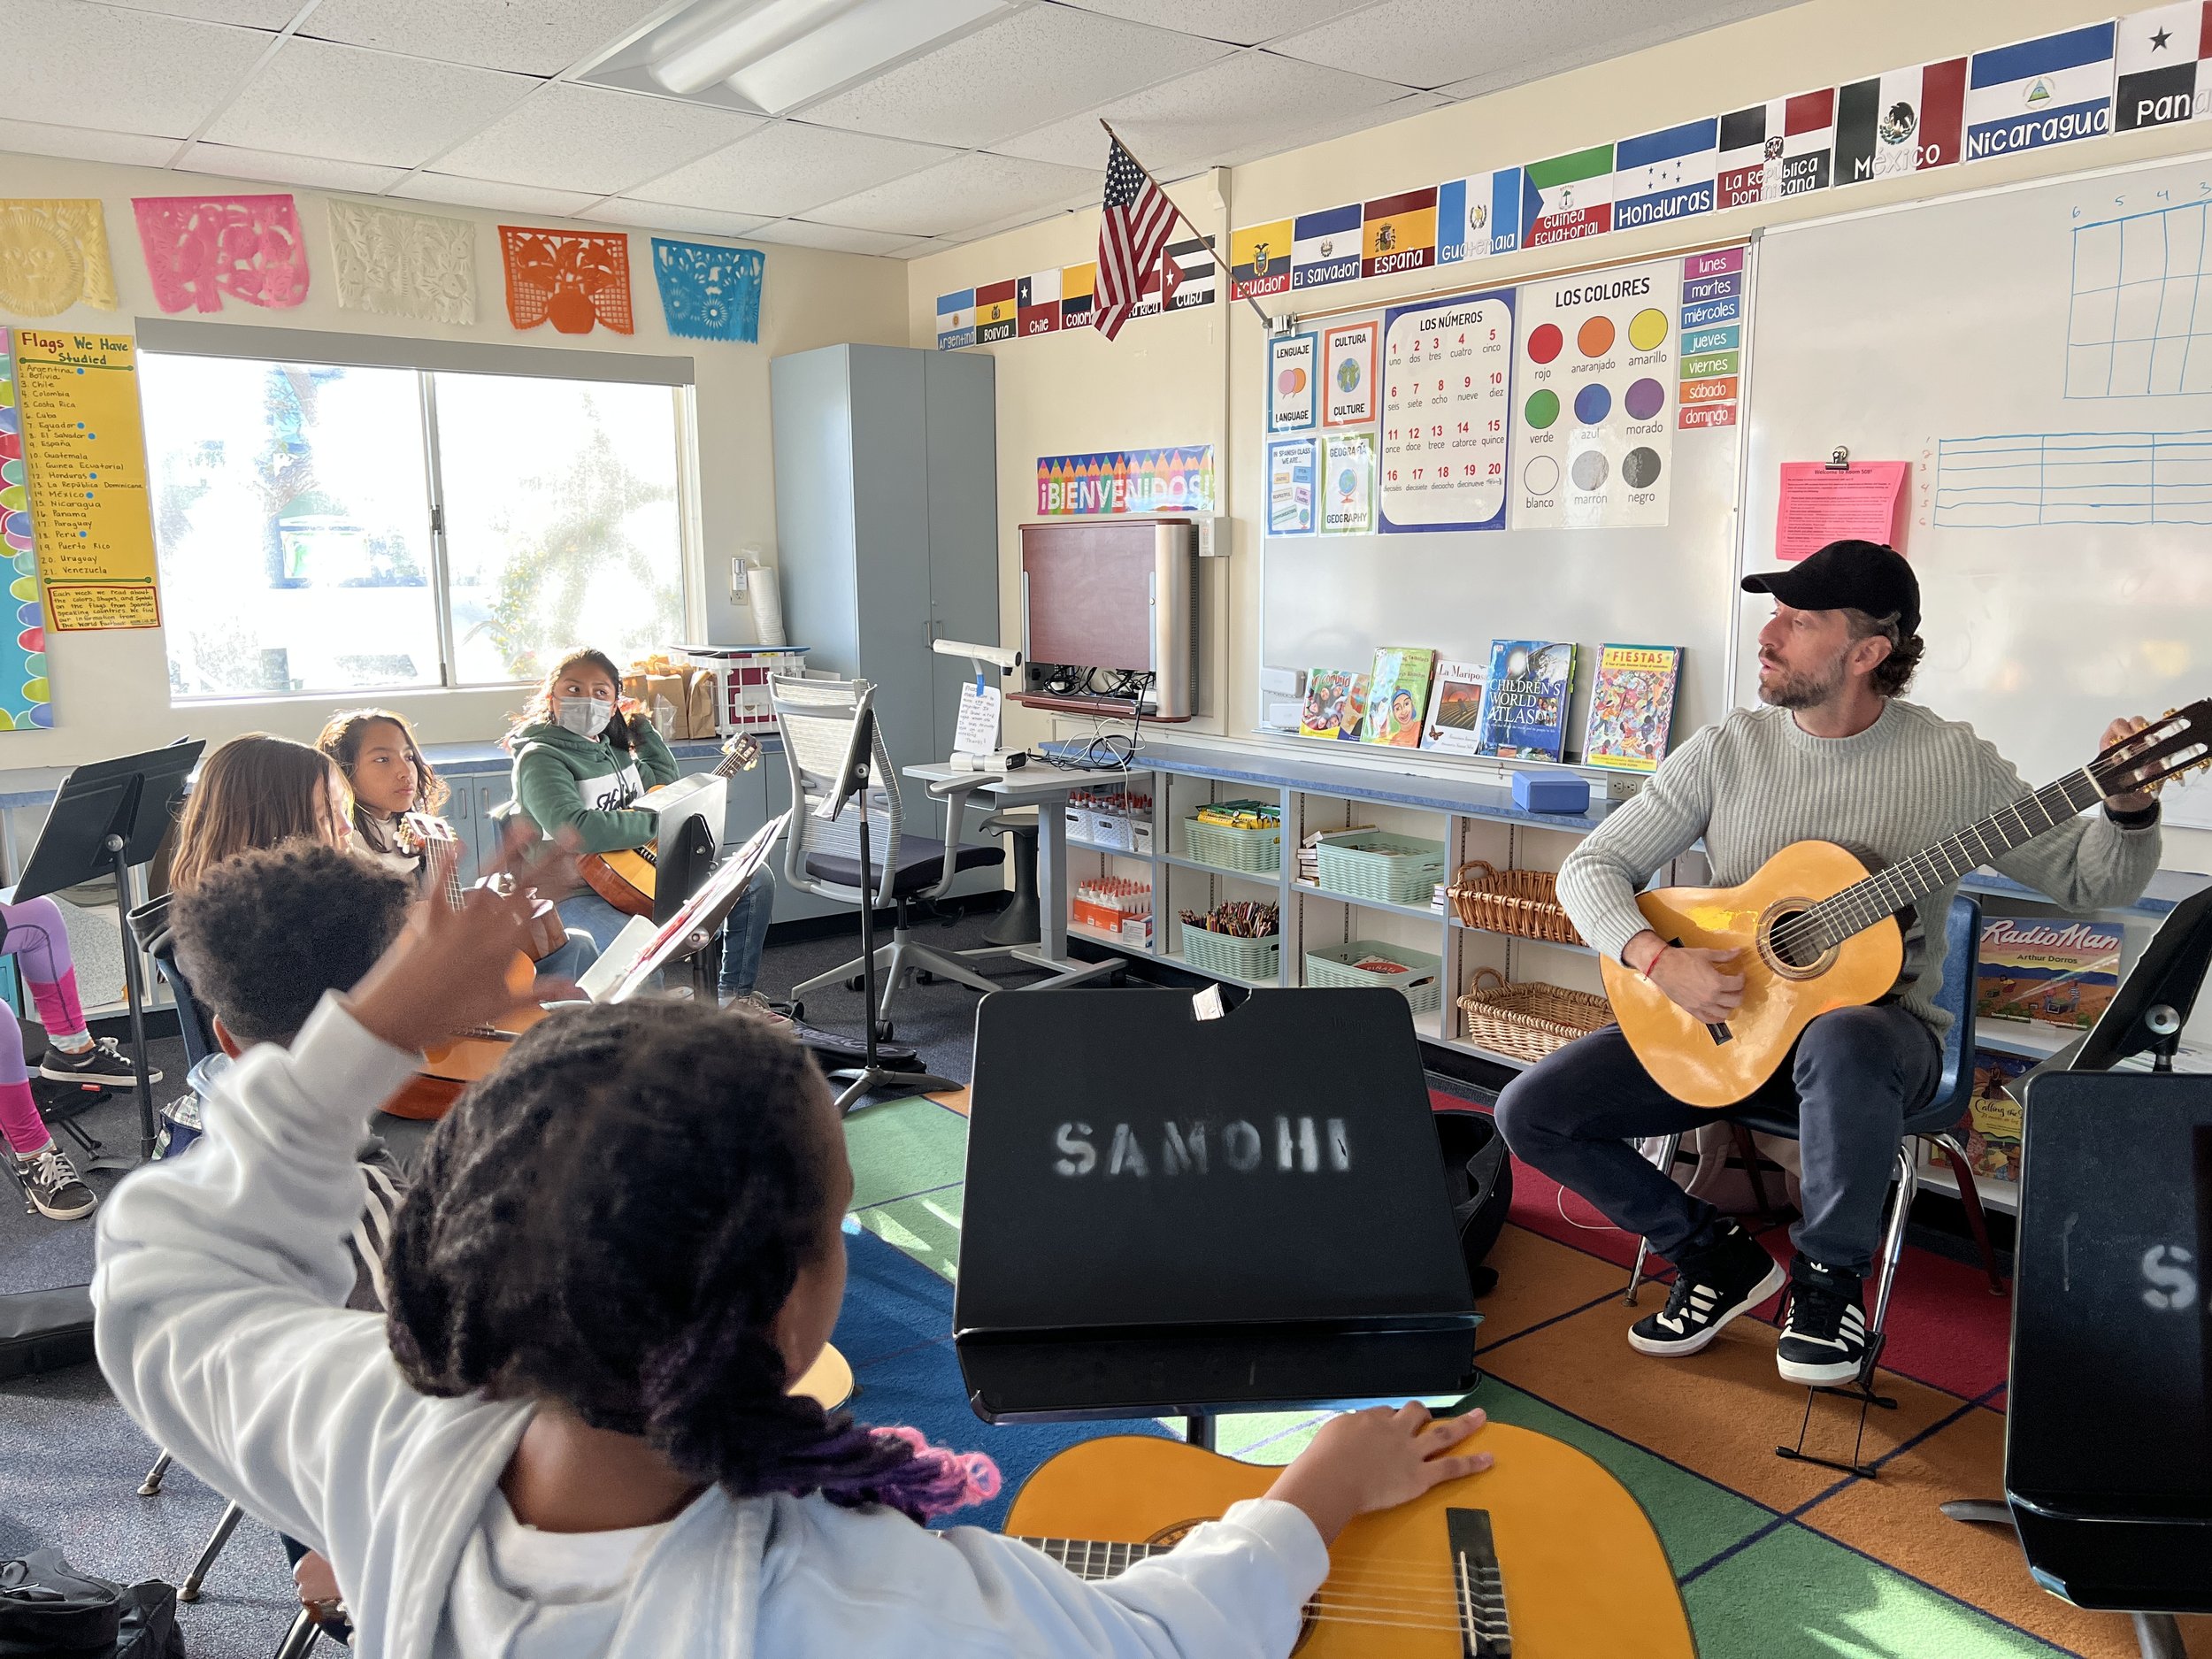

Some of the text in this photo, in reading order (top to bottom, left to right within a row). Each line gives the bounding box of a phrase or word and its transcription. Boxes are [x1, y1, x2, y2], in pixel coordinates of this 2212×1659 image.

[1968, 104, 2111, 158] Nicaragua
[1854, 143, 1940, 180] México
[1725, 157, 1818, 192] La República
[1732, 174, 1816, 207] Dominicana
[1618, 188, 1710, 227] Honduras
[1544, 209, 1585, 229] Guinea
[1534, 221, 1599, 246] Ecuatorial
[1441, 231, 1515, 261] Guatemala
[1374, 247, 1424, 274] España
[1699, 257, 1726, 273] lunes
[1294, 260, 1359, 287] El Salvador
[1236, 274, 1286, 298] Ecuador
[1555, 277, 1650, 307] LOS COLORES
[1692, 279, 1732, 299] martes
[1176, 290, 1202, 307] Cuba
[1065, 311, 1092, 327] Colom
[1420, 311, 1483, 331] LOS NÚMEROS
[1684, 302, 1735, 325] miércoles
[983, 323, 1010, 341] Bolivia
[1029, 318, 1049, 334] Chile
[21, 332, 128, 354] Flags We Have
[938, 330, 974, 350] Argentina
[1334, 334, 1367, 348] CULTURA
[1392, 329, 1496, 354] 1 2 3 4 5
[1689, 332, 1726, 353] jueves
[58, 352, 107, 365] Studied
[1276, 345, 1310, 359] LENGUAJE
[1409, 354, 1421, 364] dos
[1428, 352, 1441, 361] tres
[1450, 348, 1472, 357] cuatro
[1482, 343, 1501, 353] cinco
[27, 364, 73, 373] Argentina
[1534, 352, 1667, 381] rojo anaranjado amarillo
[1688, 356, 1728, 374] viernes
[1391, 373, 1502, 397] 6 7 8 9 10
[1689, 382, 1726, 399] sábado
[1408, 400, 1423, 409] siete
[1432, 395, 1448, 405] ocho
[1457, 392, 1479, 401] nueve
[1489, 388, 1504, 397] diez
[1275, 411, 1310, 423] LANGUAGE
[1333, 403, 1365, 416] CULTURE
[1686, 408, 1729, 427] domingo
[39, 422, 75, 432] Equador
[1387, 419, 1500, 441] 11 12 13 14 15
[1530, 421, 1663, 443] verde azul morado
[1386, 435, 1504, 454] once doce trece catorce quince
[1386, 463, 1501, 480] 16 17 18 19 20
[50, 500, 102, 510] Nicaragua
[1525, 497, 1554, 508] blanco
[1627, 493, 1655, 505] negro
[54, 519, 92, 529] Paraguay
[1327, 512, 1367, 523] GEOGRAPHY
[60, 555, 97, 565] Uruguay
[1612, 651, 1663, 664] FIESTAS
[1439, 664, 1449, 676] La
[1490, 678, 1561, 696] CHILDREN'S
[1489, 691, 1537, 708] WORLD
[1486, 705, 1535, 725] ATLAS
[1052, 1117, 1352, 1177] SAMOHI
[2142, 1244, 2197, 1310] S
